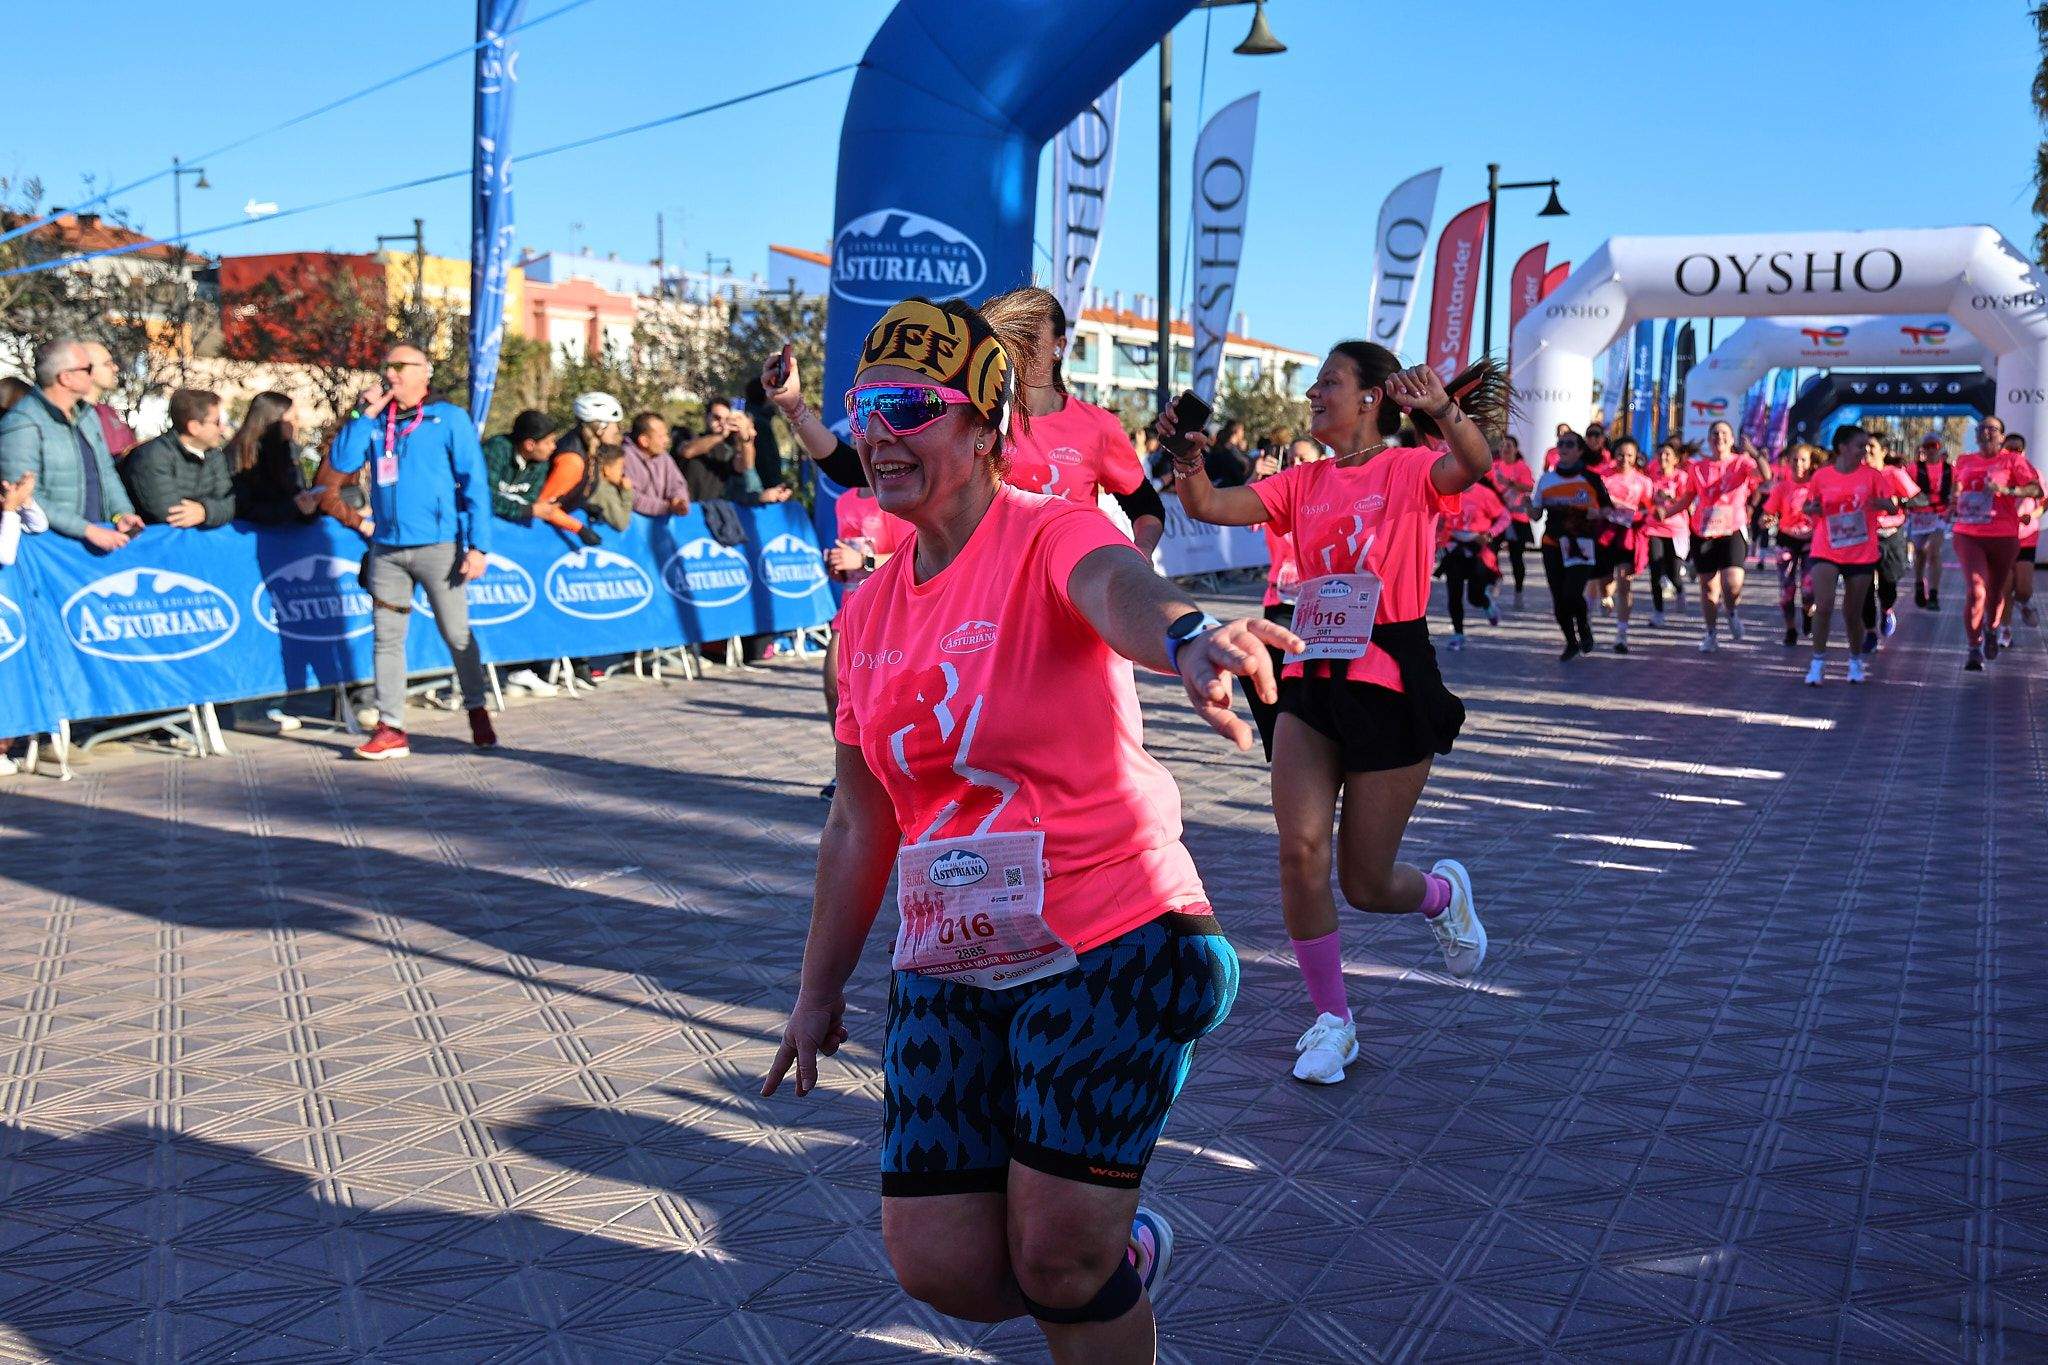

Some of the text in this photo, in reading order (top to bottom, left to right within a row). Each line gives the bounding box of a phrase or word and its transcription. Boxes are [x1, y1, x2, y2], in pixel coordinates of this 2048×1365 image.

[836, 247, 972, 286] ASTURIANA
[1376, 218, 1427, 339] SHO
[1675, 248, 1903, 297] OYSHO
[1441, 239, 1472, 353] Santander
[1972, 293, 2046, 311] OYSHO
[1546, 304, 1609, 319] OYSHO
[1850, 382, 1961, 394] VOLVO
[556, 573, 649, 602] ASTURIANA
[675, 566, 748, 591] ASTURIANA
[269, 591, 374, 624] ASTURIAN
[1314, 612, 1346, 626] 016
[80, 605, 229, 644] ASTURIANA
[945, 632, 997, 650] ASTURIANA
[933, 865, 986, 881] ASTURIANA
[939, 912, 995, 945] 016
[918, 966, 951, 976] CARRERA
[953, 964, 963, 972] DE
[974, 956, 1001, 968] MUJER
[1005, 951, 1042, 963] VALENCIA
[955, 945, 987, 960] 2885
[1005, 958, 1056, 979] Santander
